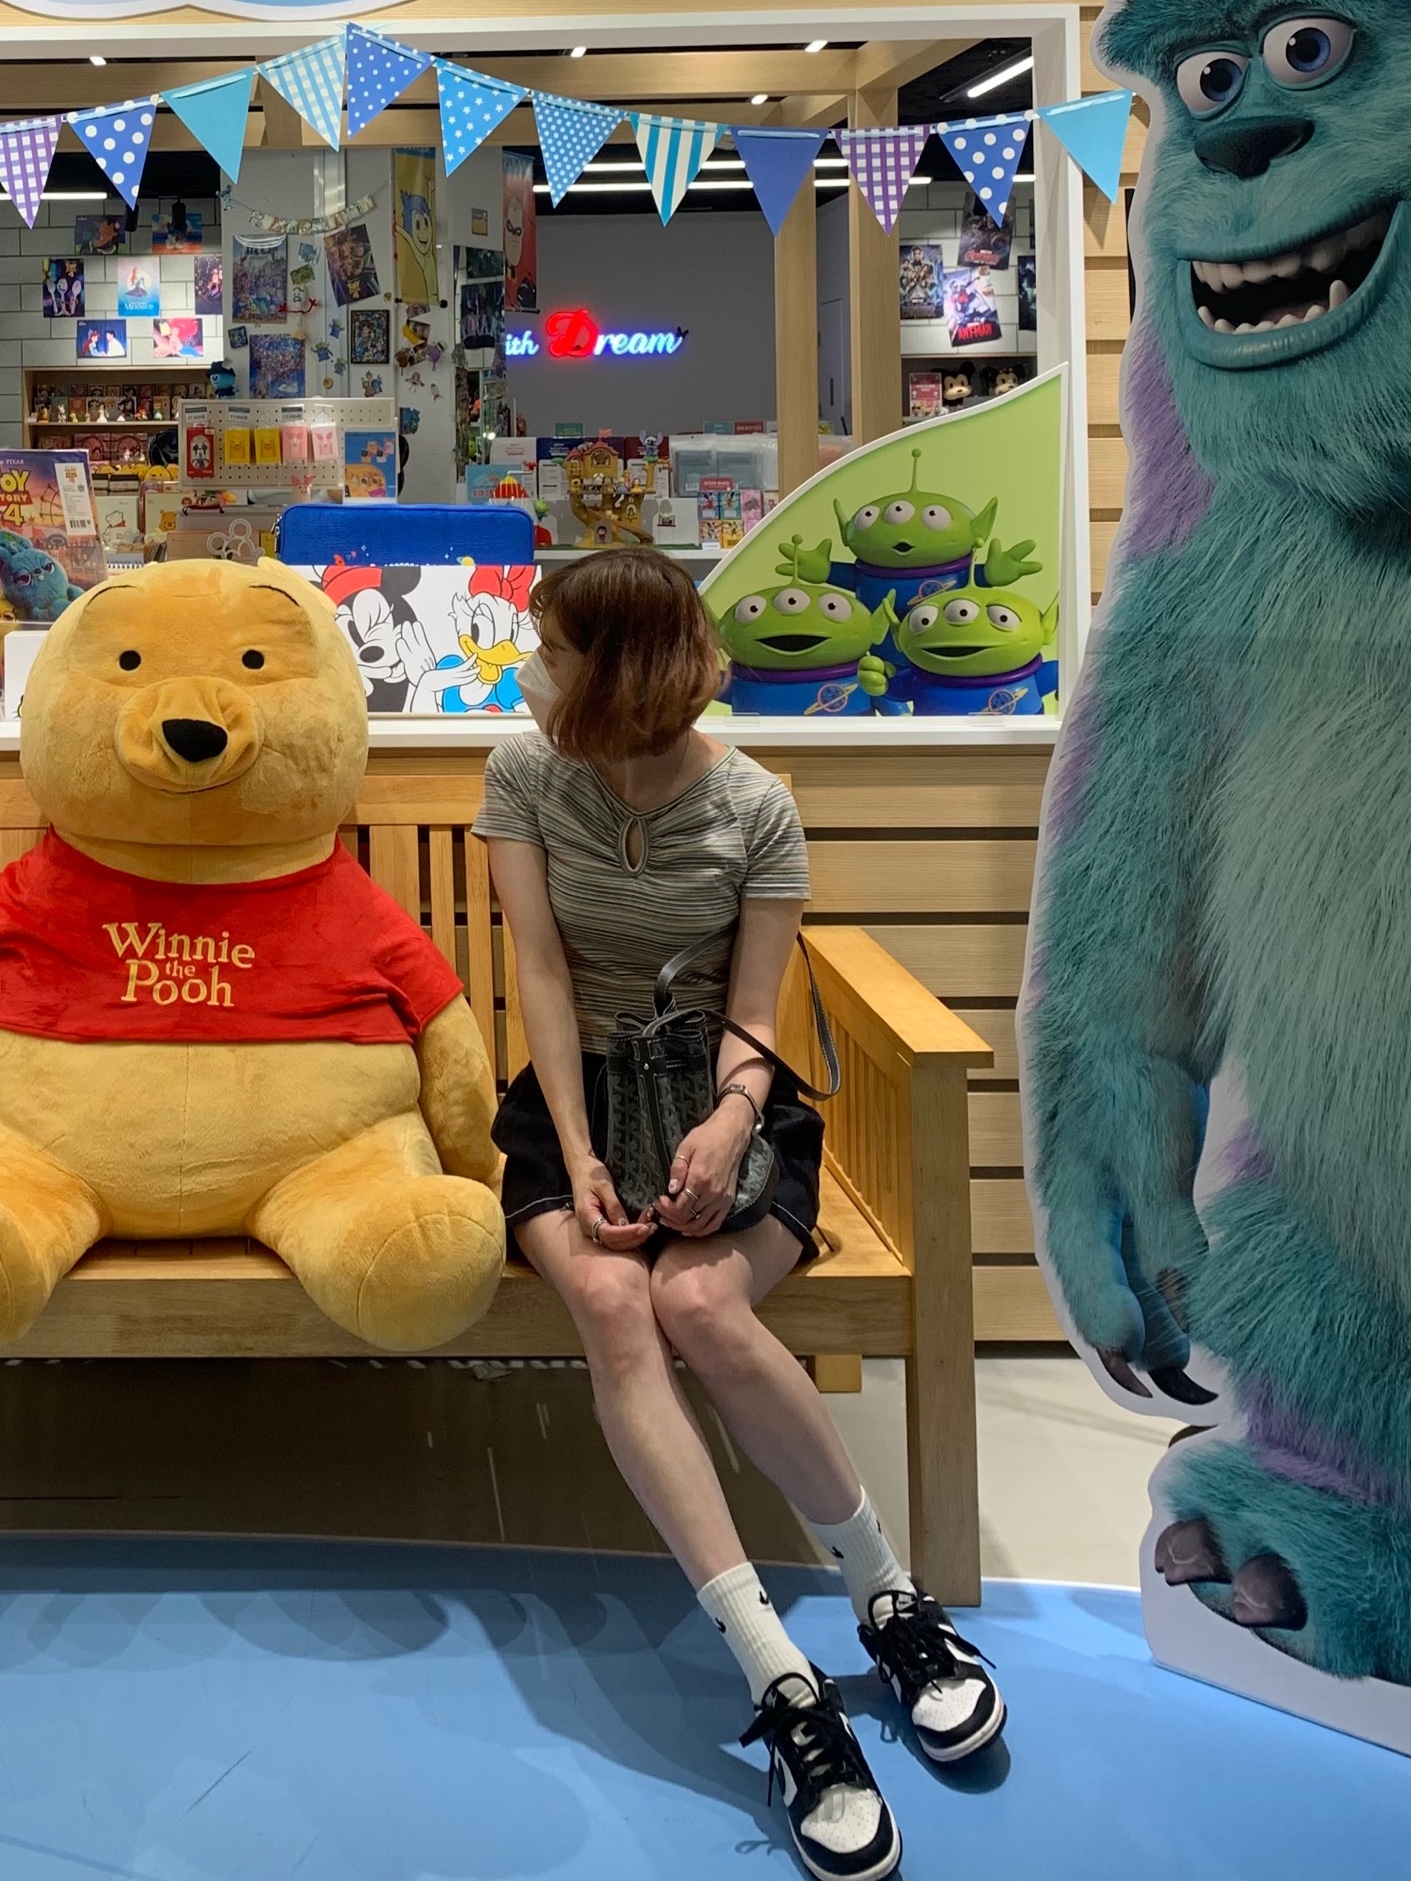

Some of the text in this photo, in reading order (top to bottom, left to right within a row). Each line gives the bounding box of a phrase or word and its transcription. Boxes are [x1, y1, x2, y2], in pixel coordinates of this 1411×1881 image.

[505, 309, 683, 358] ith Dream
[0, 468, 31, 493] OY
[0, 493, 28, 503] TORY
[3, 502, 24, 527] 4
[102, 922, 256, 968] Winnie
[165, 960, 196, 979] the
[121, 959, 235, 1007] Pooh
